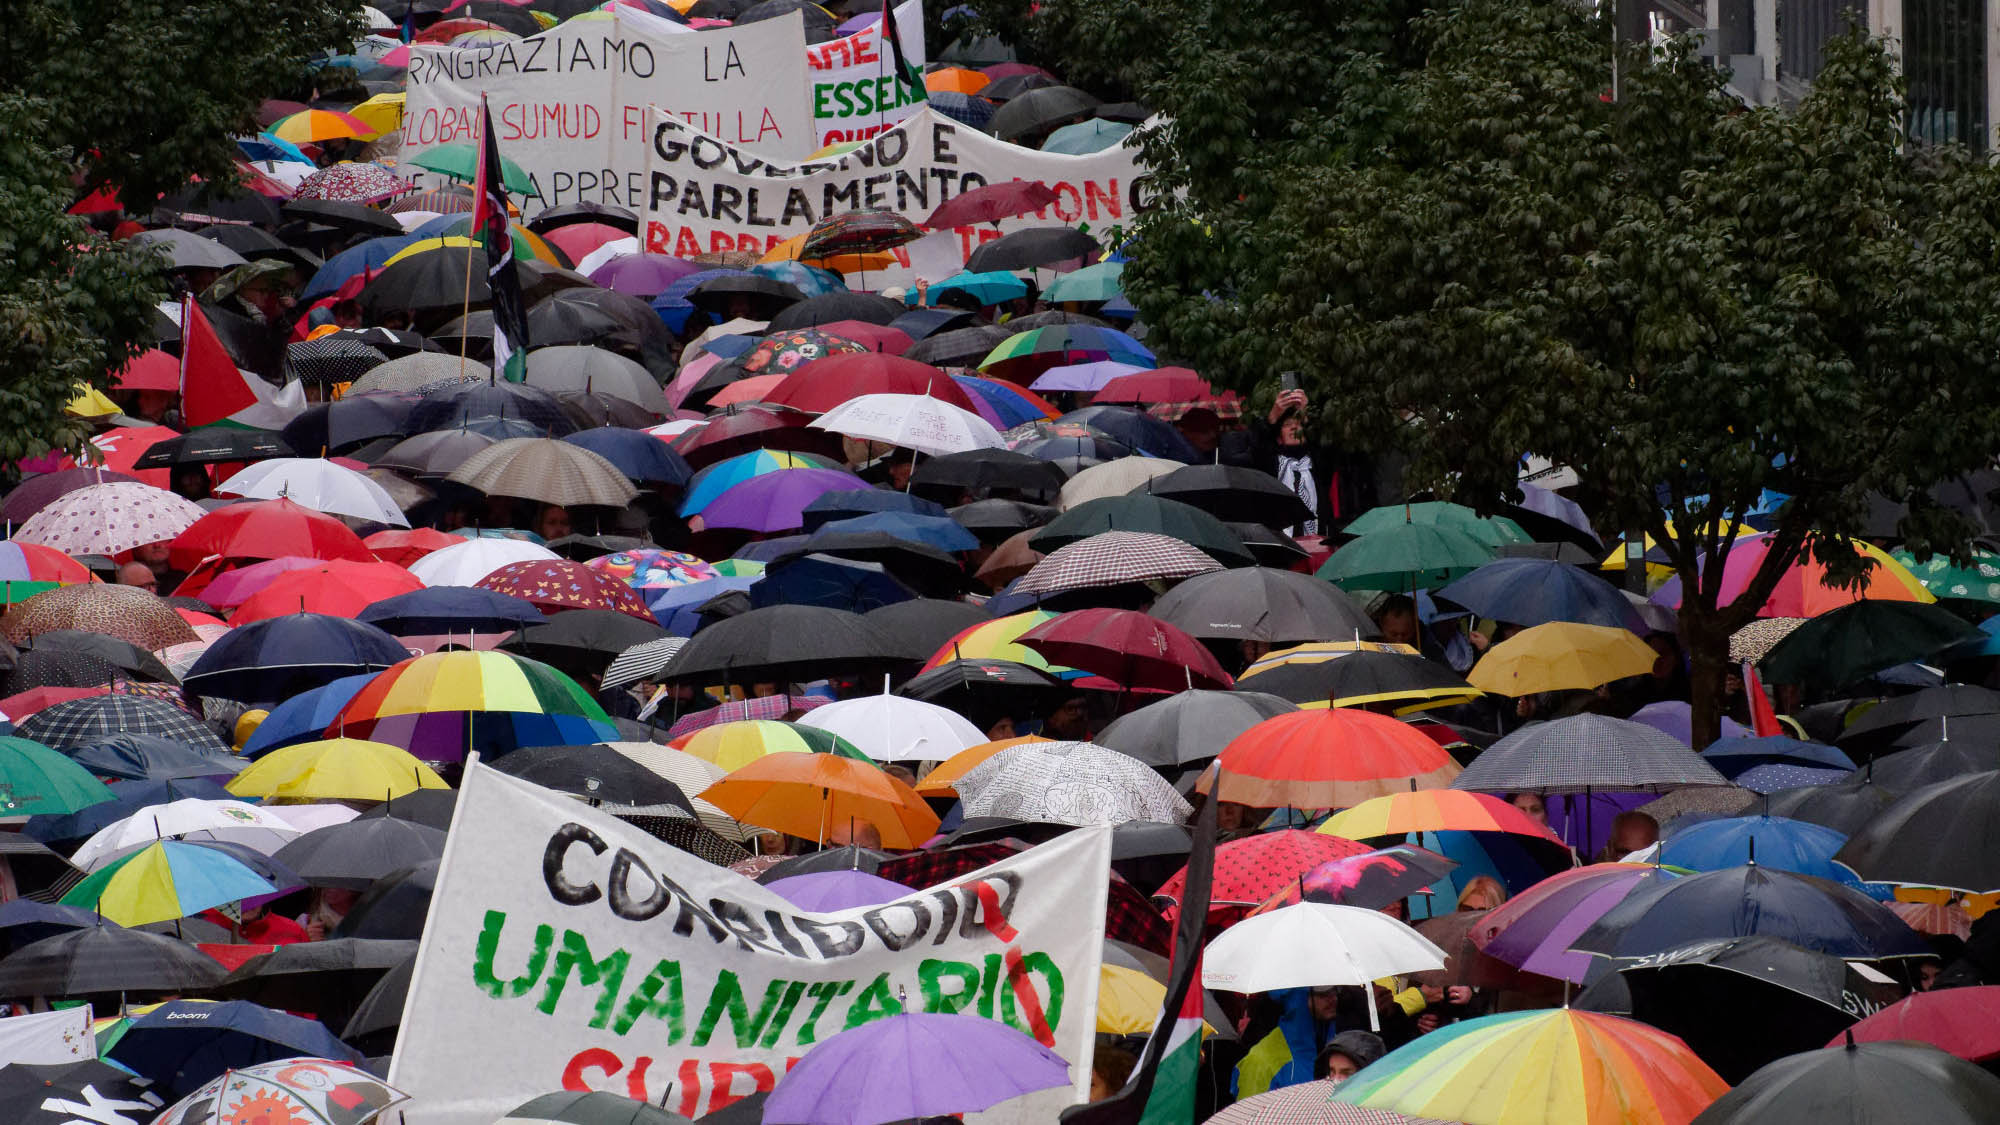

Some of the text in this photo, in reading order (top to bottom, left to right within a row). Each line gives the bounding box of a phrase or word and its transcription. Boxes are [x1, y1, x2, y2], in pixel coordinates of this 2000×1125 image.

[409, 37, 746, 84] RINGRAZIAMO LA
[502, 103, 600, 141] SUMUD
[934, 123, 957, 163] E
[473, 909, 1065, 1049] UMANITARIO
[166, 1011, 211, 1020] boomi
